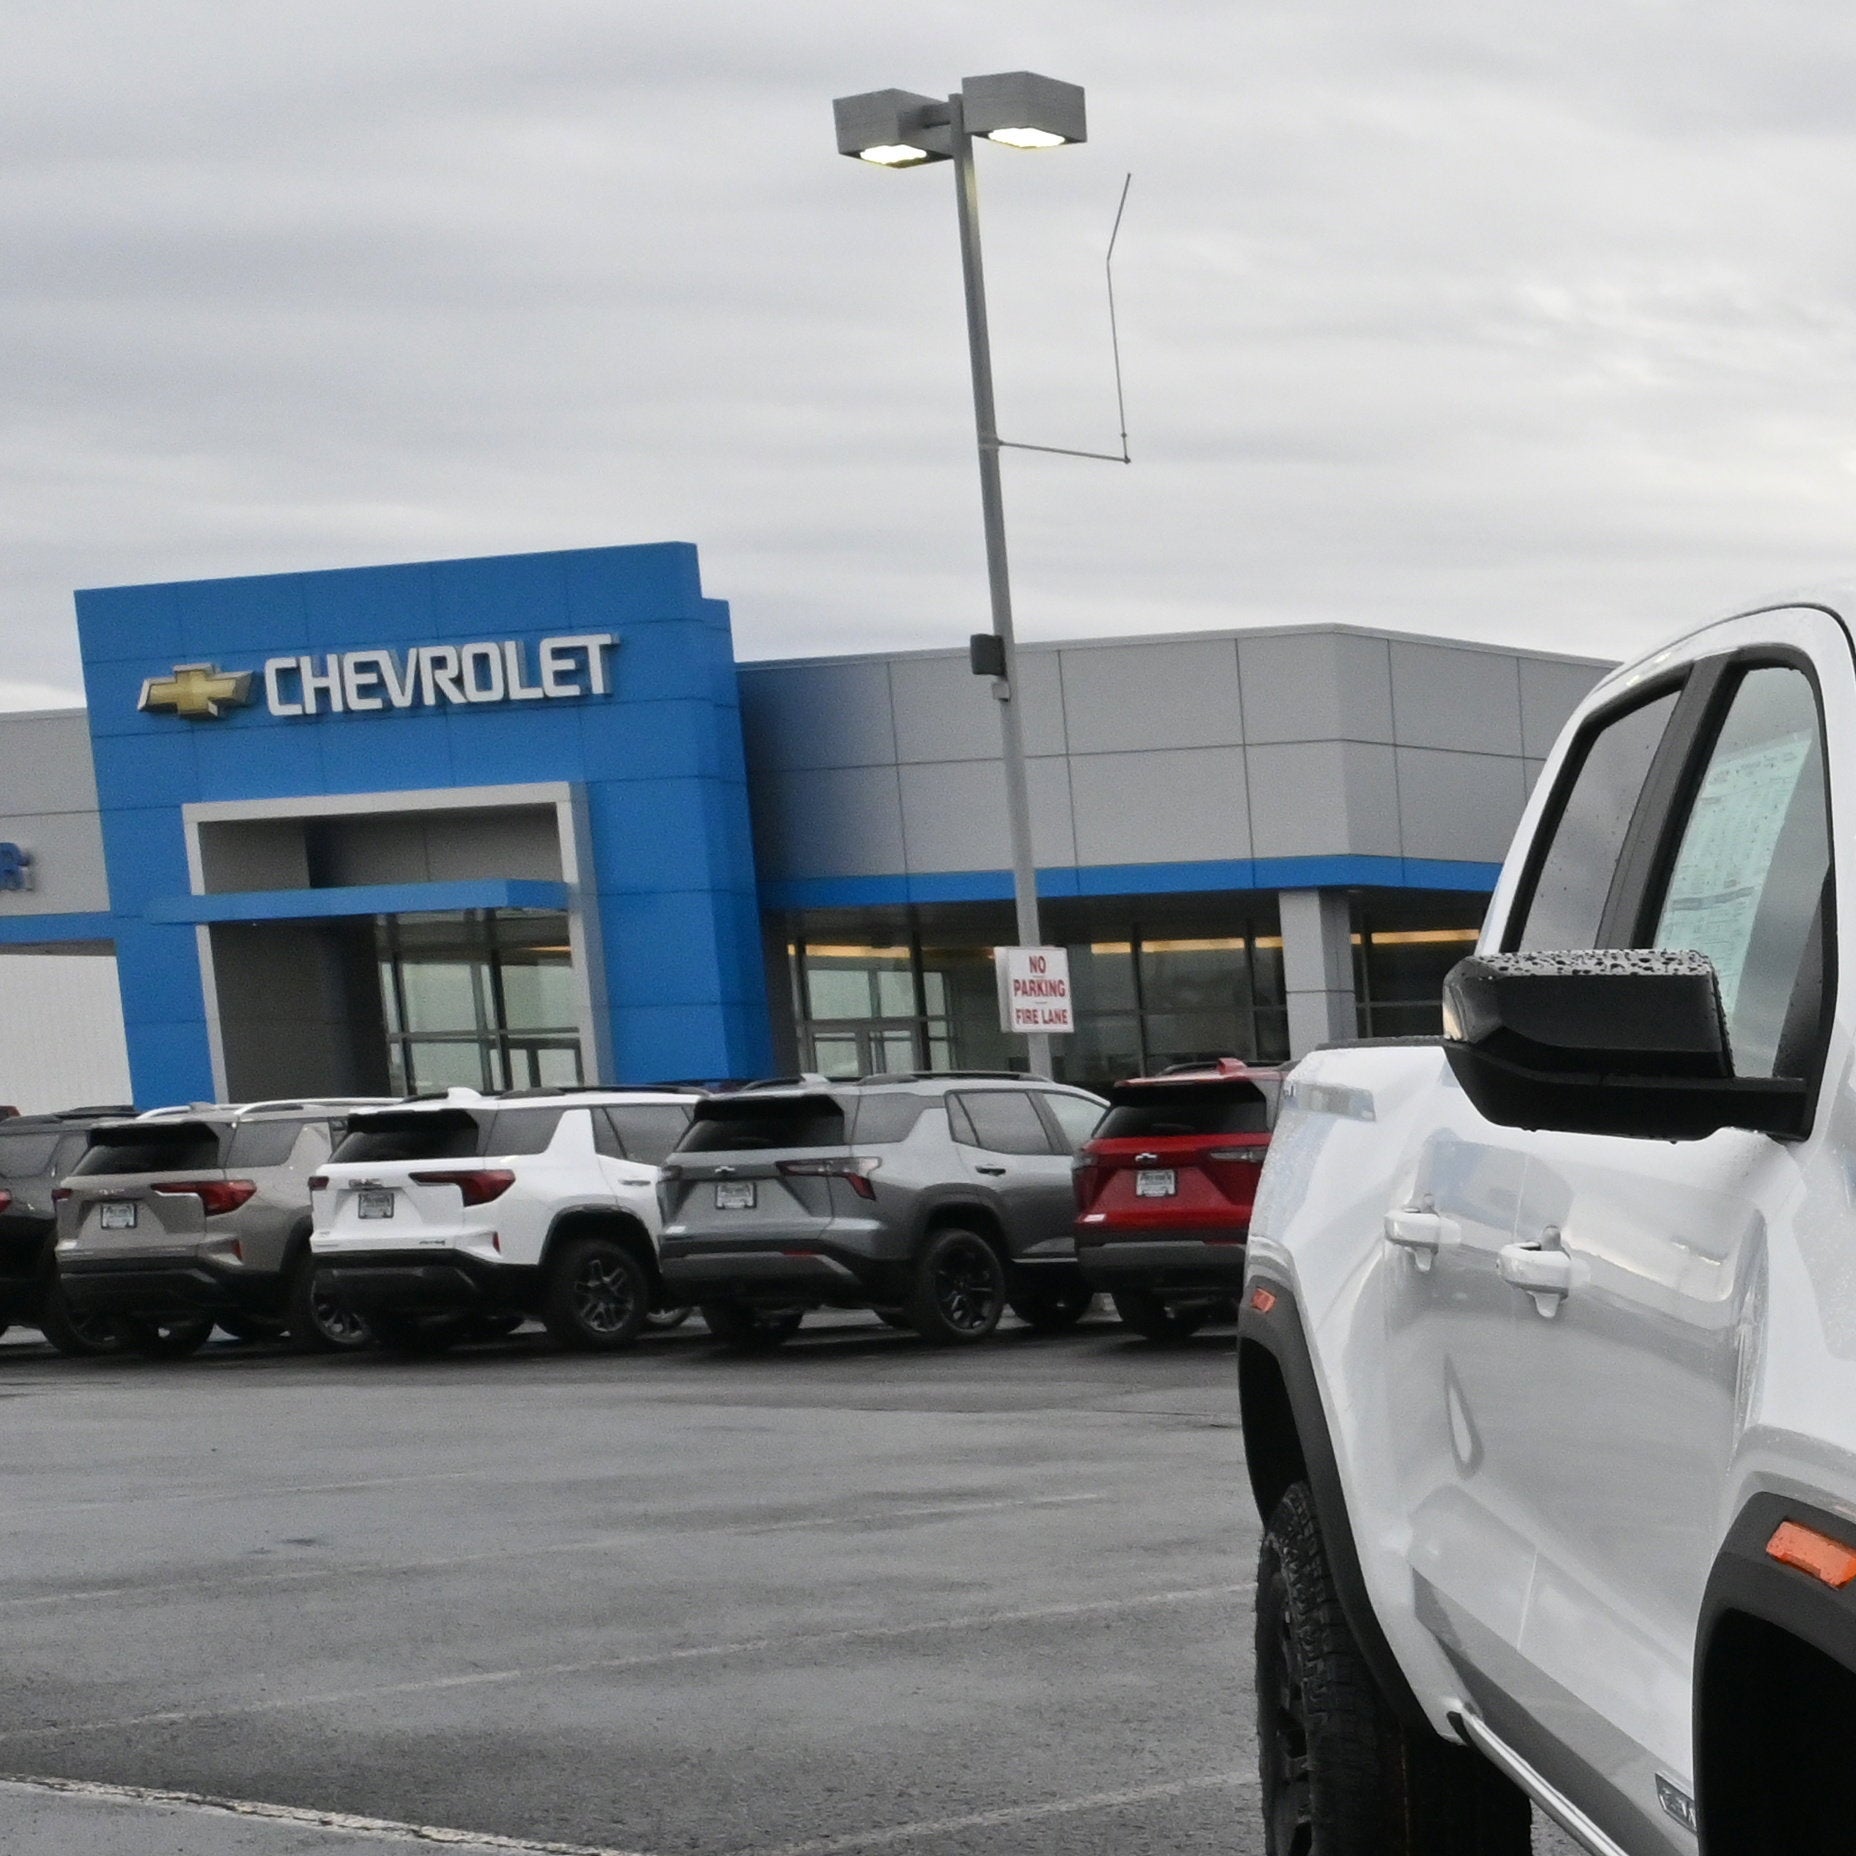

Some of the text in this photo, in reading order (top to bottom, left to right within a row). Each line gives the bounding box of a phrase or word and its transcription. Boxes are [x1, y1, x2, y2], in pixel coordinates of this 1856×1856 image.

[265, 634, 615, 716] CHEVROLET
[1029, 955, 1046, 974] NO
[1013, 979, 1066, 997] PARKING
[1015, 1008, 1068, 1024] FIRE LANE
